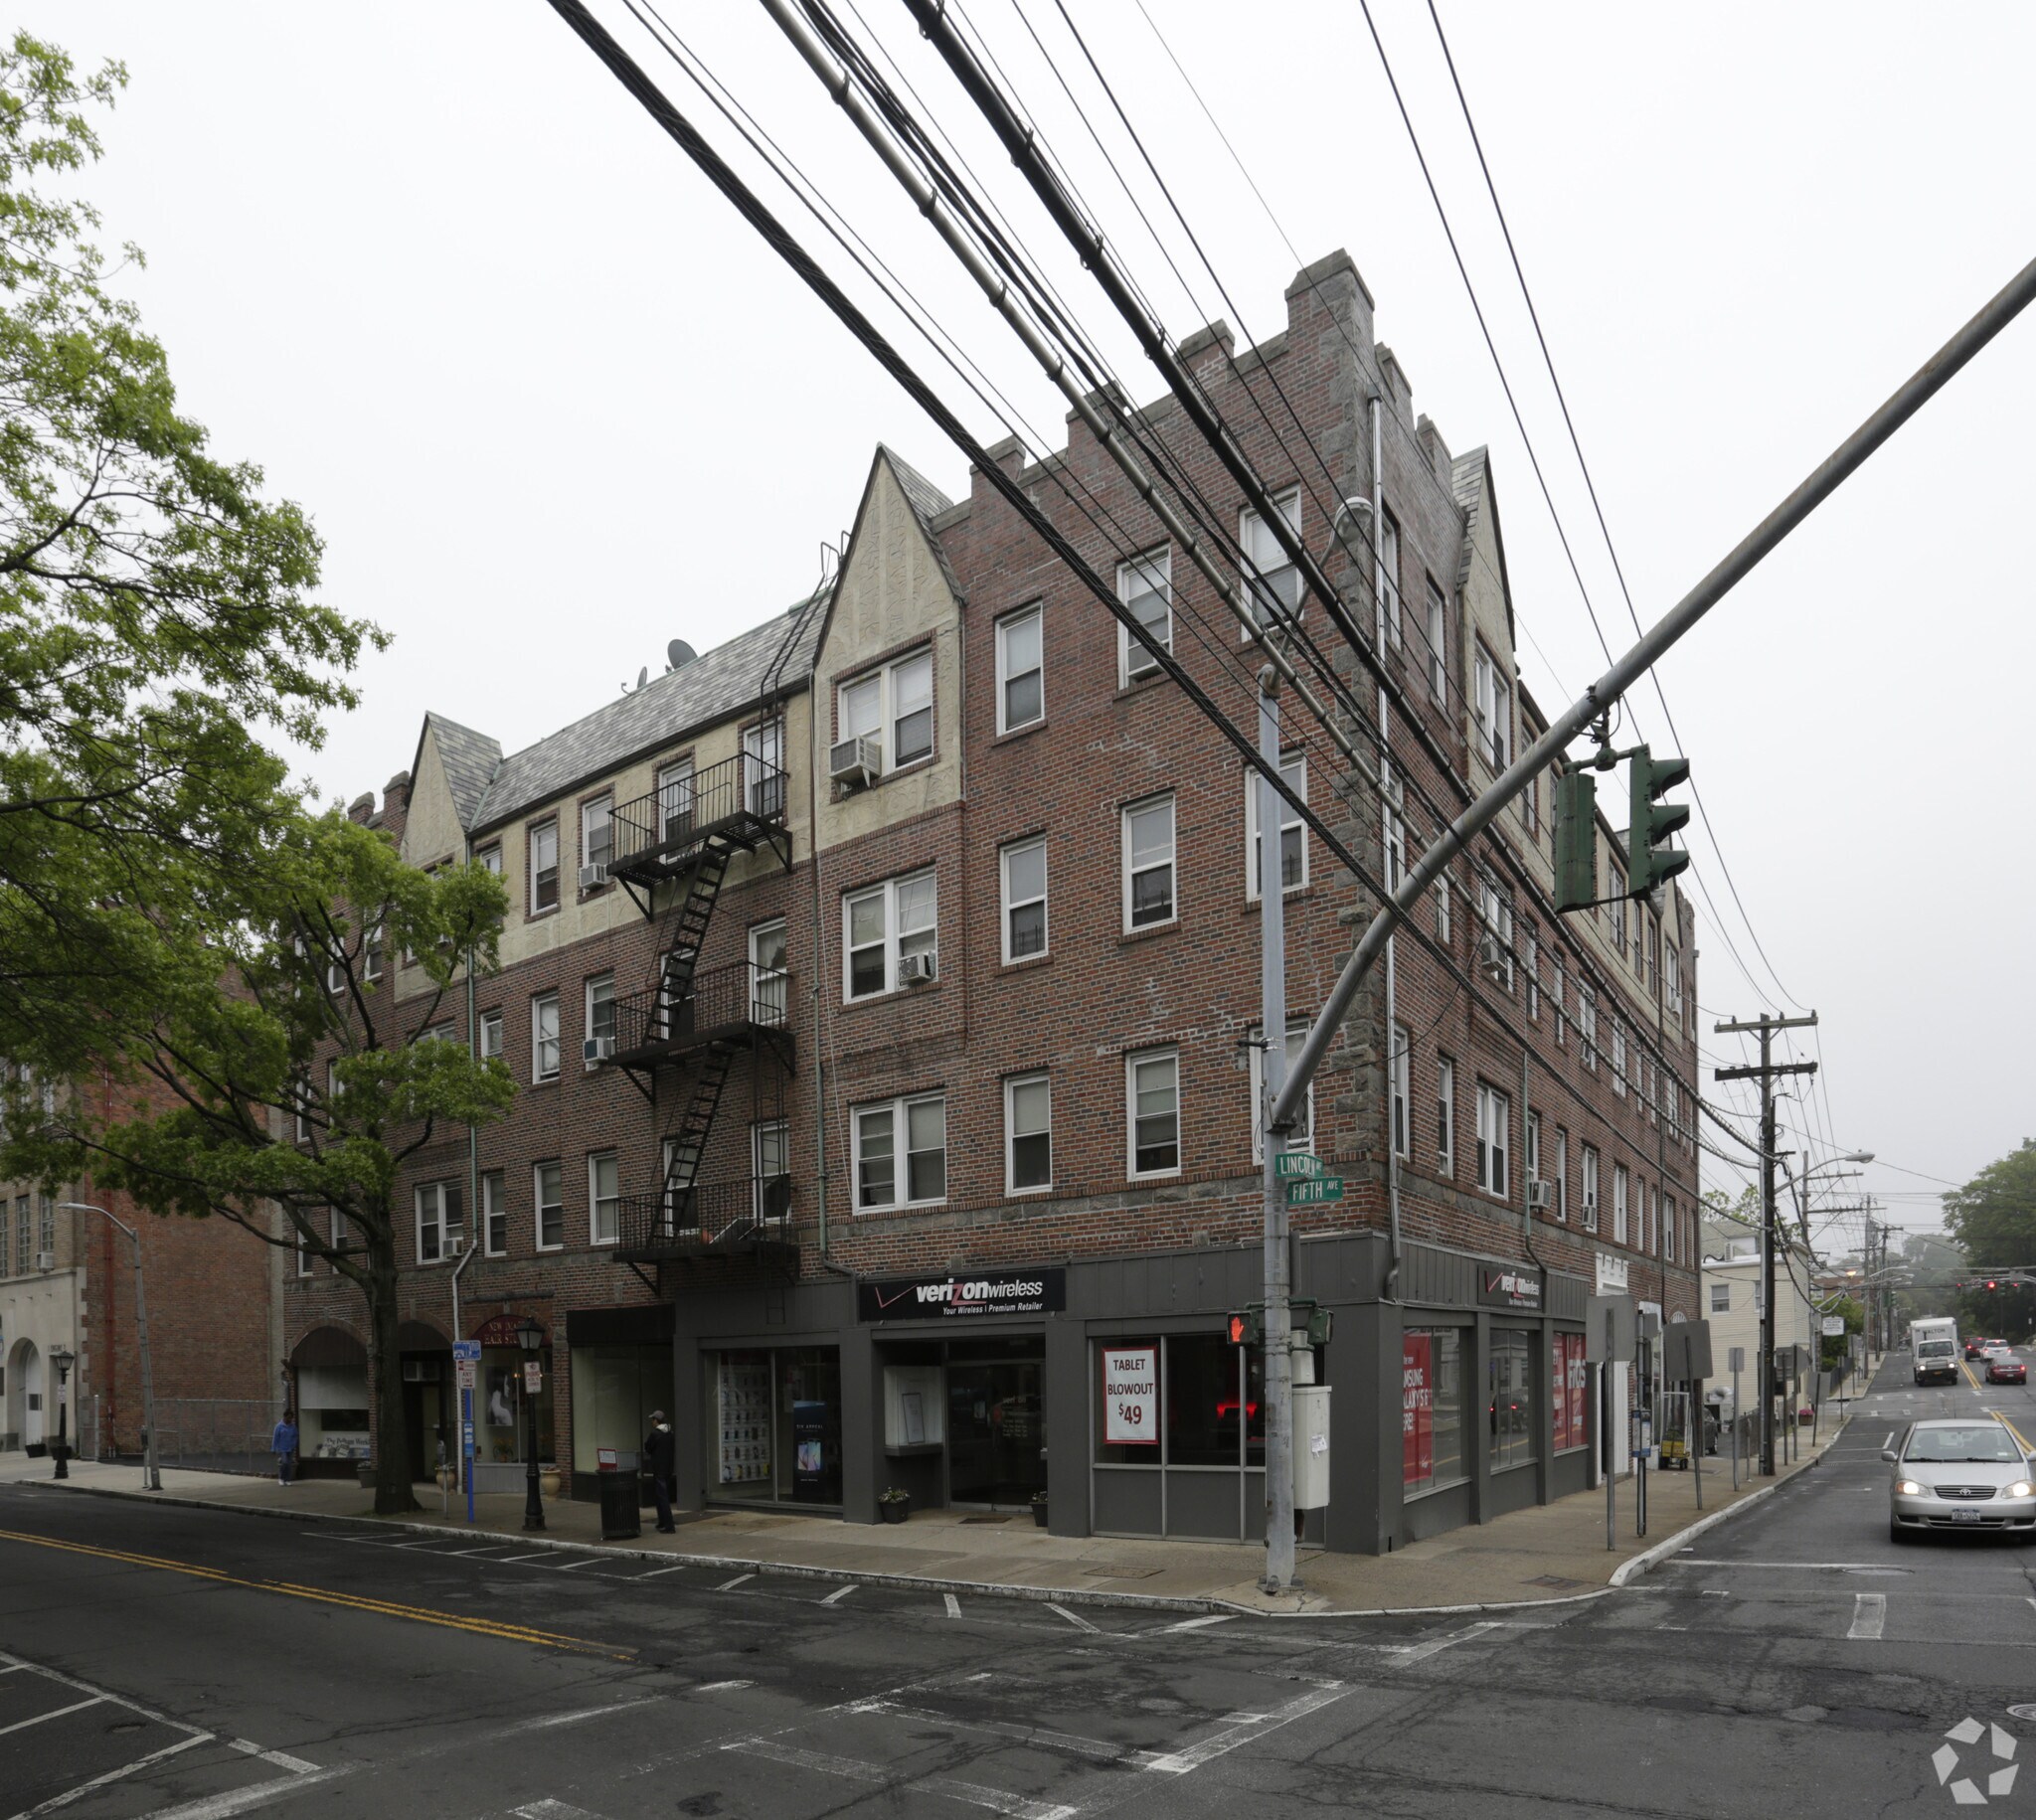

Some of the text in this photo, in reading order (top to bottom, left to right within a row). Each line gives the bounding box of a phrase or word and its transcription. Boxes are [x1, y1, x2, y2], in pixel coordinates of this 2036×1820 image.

[1292, 1180, 1338, 1202] FIFTH AVE
[943, 1305, 957, 1315] Your
[958, 1303, 983, 1313] Wireless
[988, 1300, 1015, 1312] Premium
[1017, 1300, 1043, 1310] Retailer
[1112, 1359, 1145, 1372] TABLET
[1107, 1383, 1153, 1396] BLOWOUT
[1118, 1402, 1142, 1425] $49
